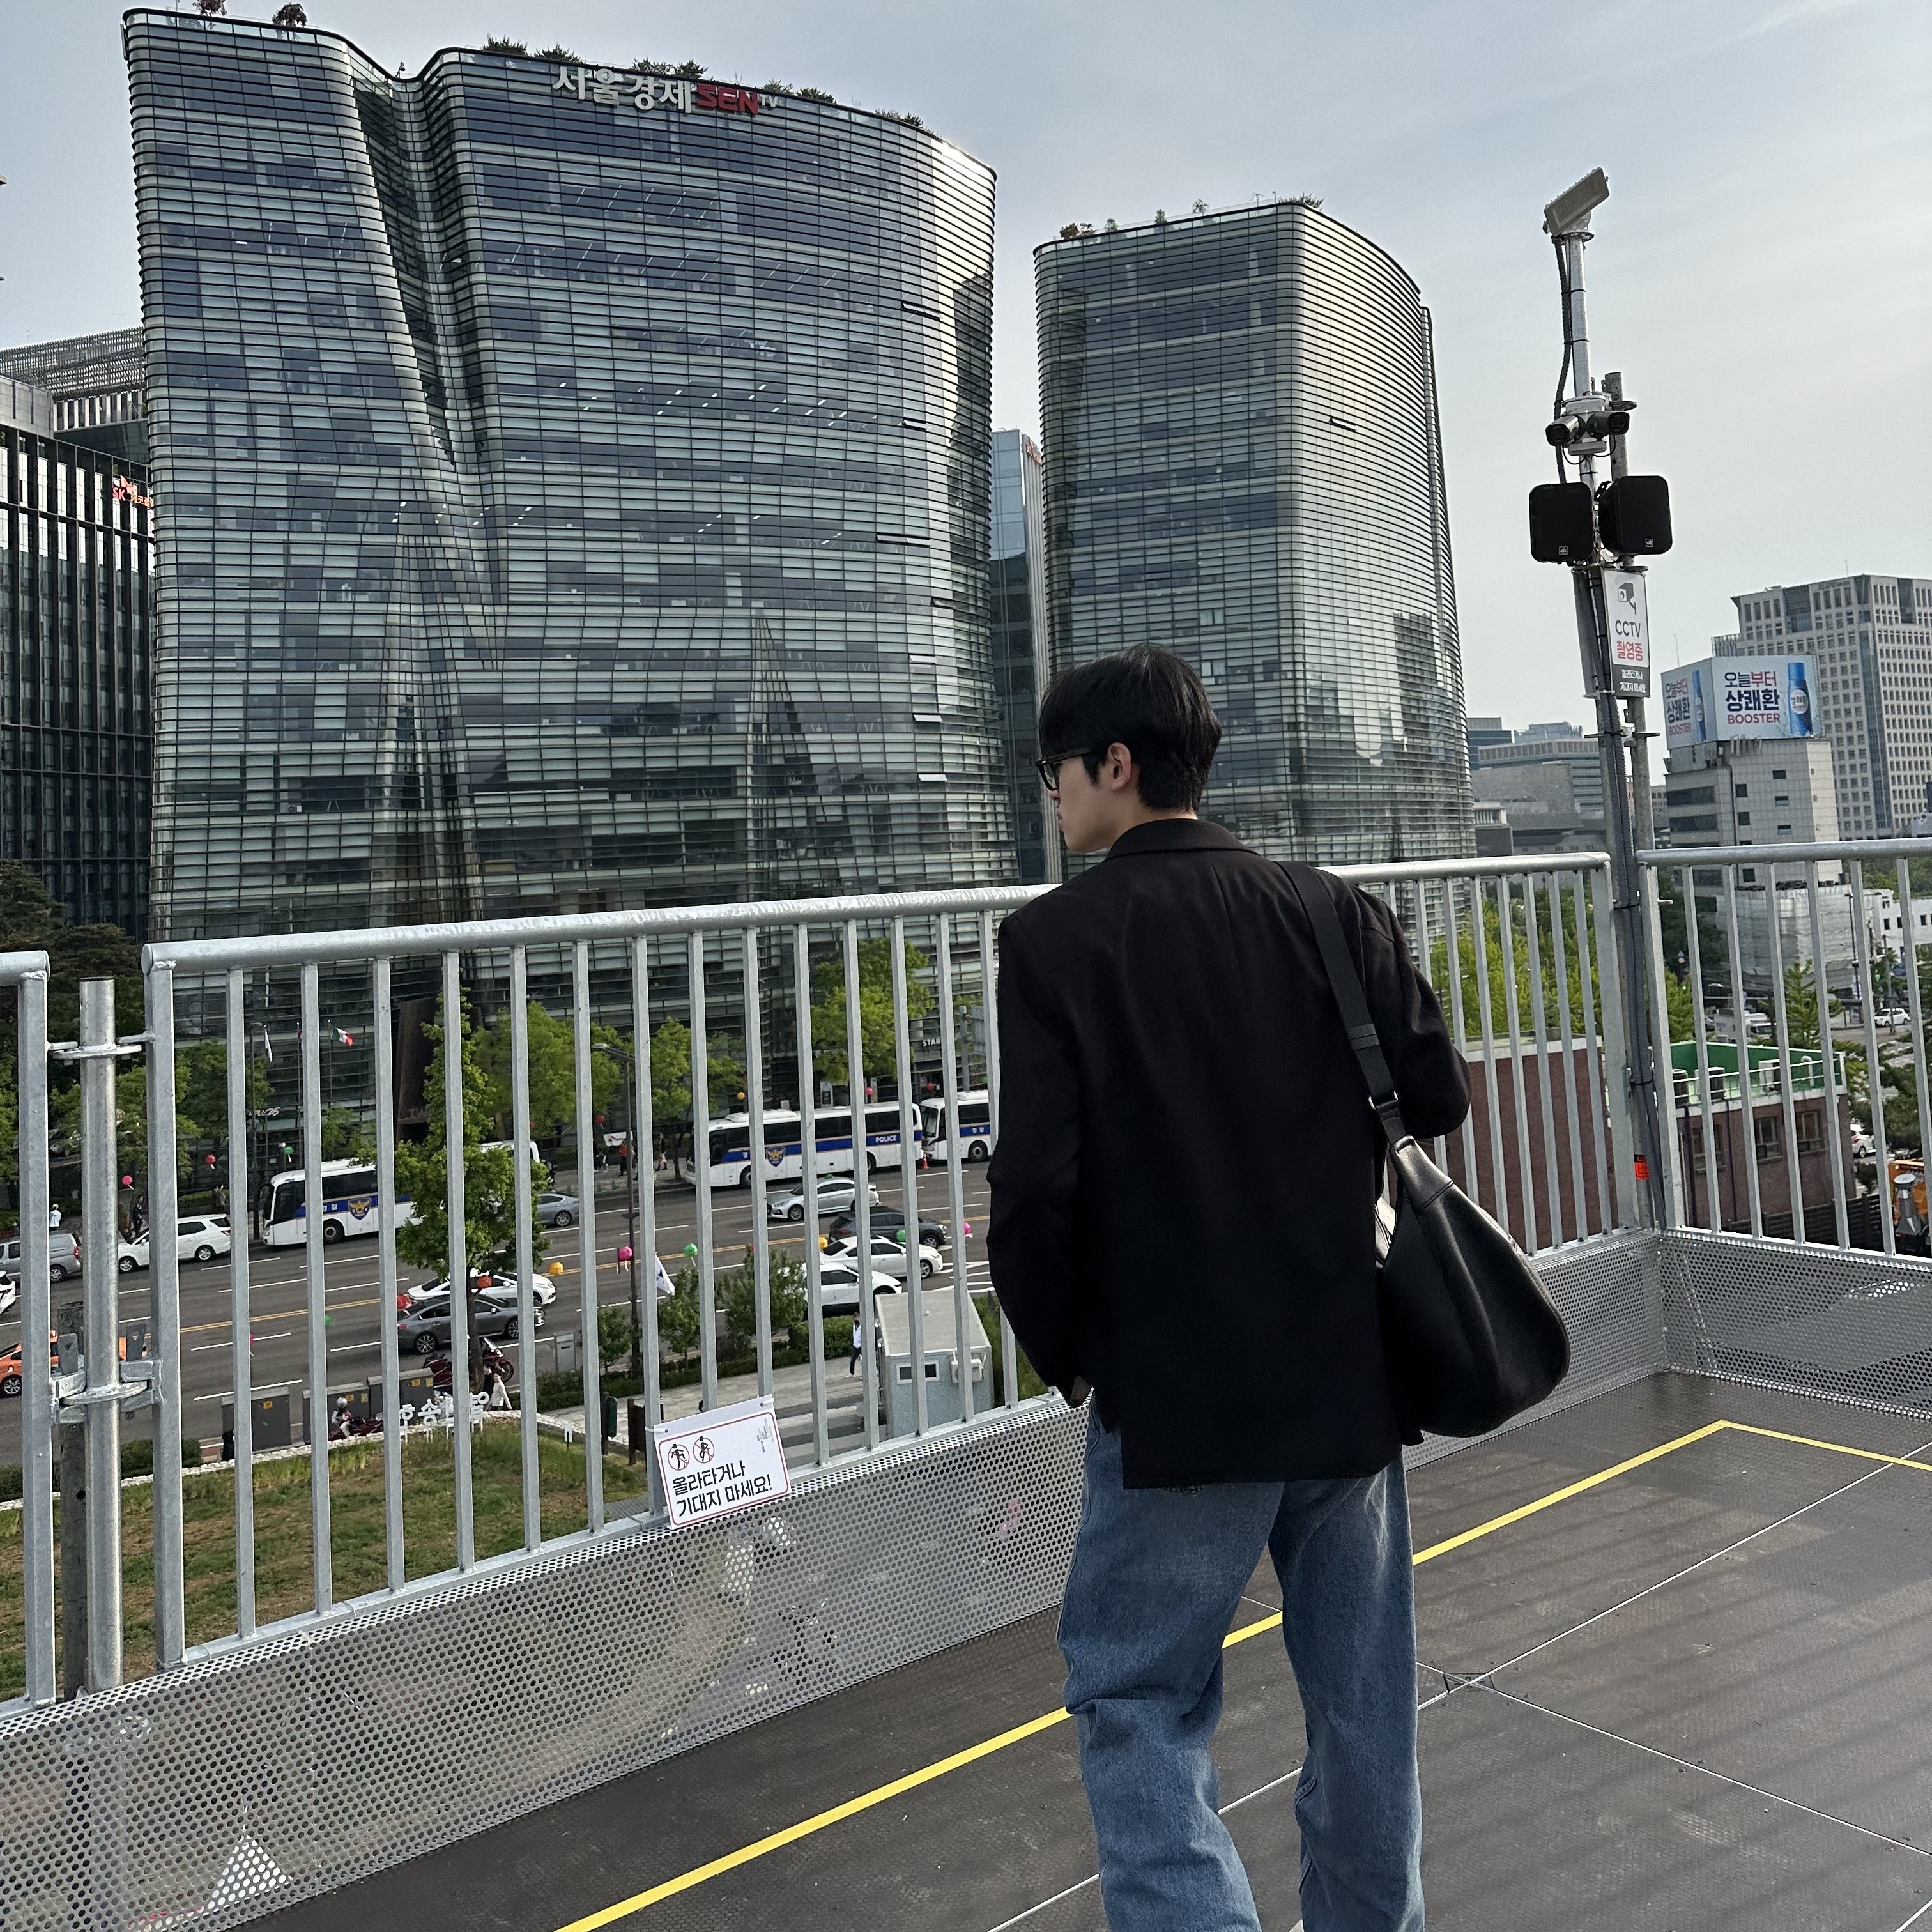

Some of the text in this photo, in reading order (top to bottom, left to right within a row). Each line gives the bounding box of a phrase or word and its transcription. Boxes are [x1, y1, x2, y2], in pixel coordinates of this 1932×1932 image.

[552, 66, 692, 114] 서울경제
[696, 82, 758, 114] SEN
[1615, 620, 1641, 638] CCTV
[1616, 640, 1643, 661] 촬영중
[1666, 678, 1688, 699] 오늘부터
[1724, 671, 1777, 688] 오늘부터
[1667, 696, 1690, 723] 상쾌환
[1726, 688, 1780, 712] 상쾌환
[1668, 722, 1692, 736] BOOSTER
[1728, 713, 1781, 724] BOOSTER
[875, 1135, 897, 1144] POLICE
[673, 1460, 746, 1496] 올라타거나
[677, 1474, 772, 1517] 기대지 마세요!
